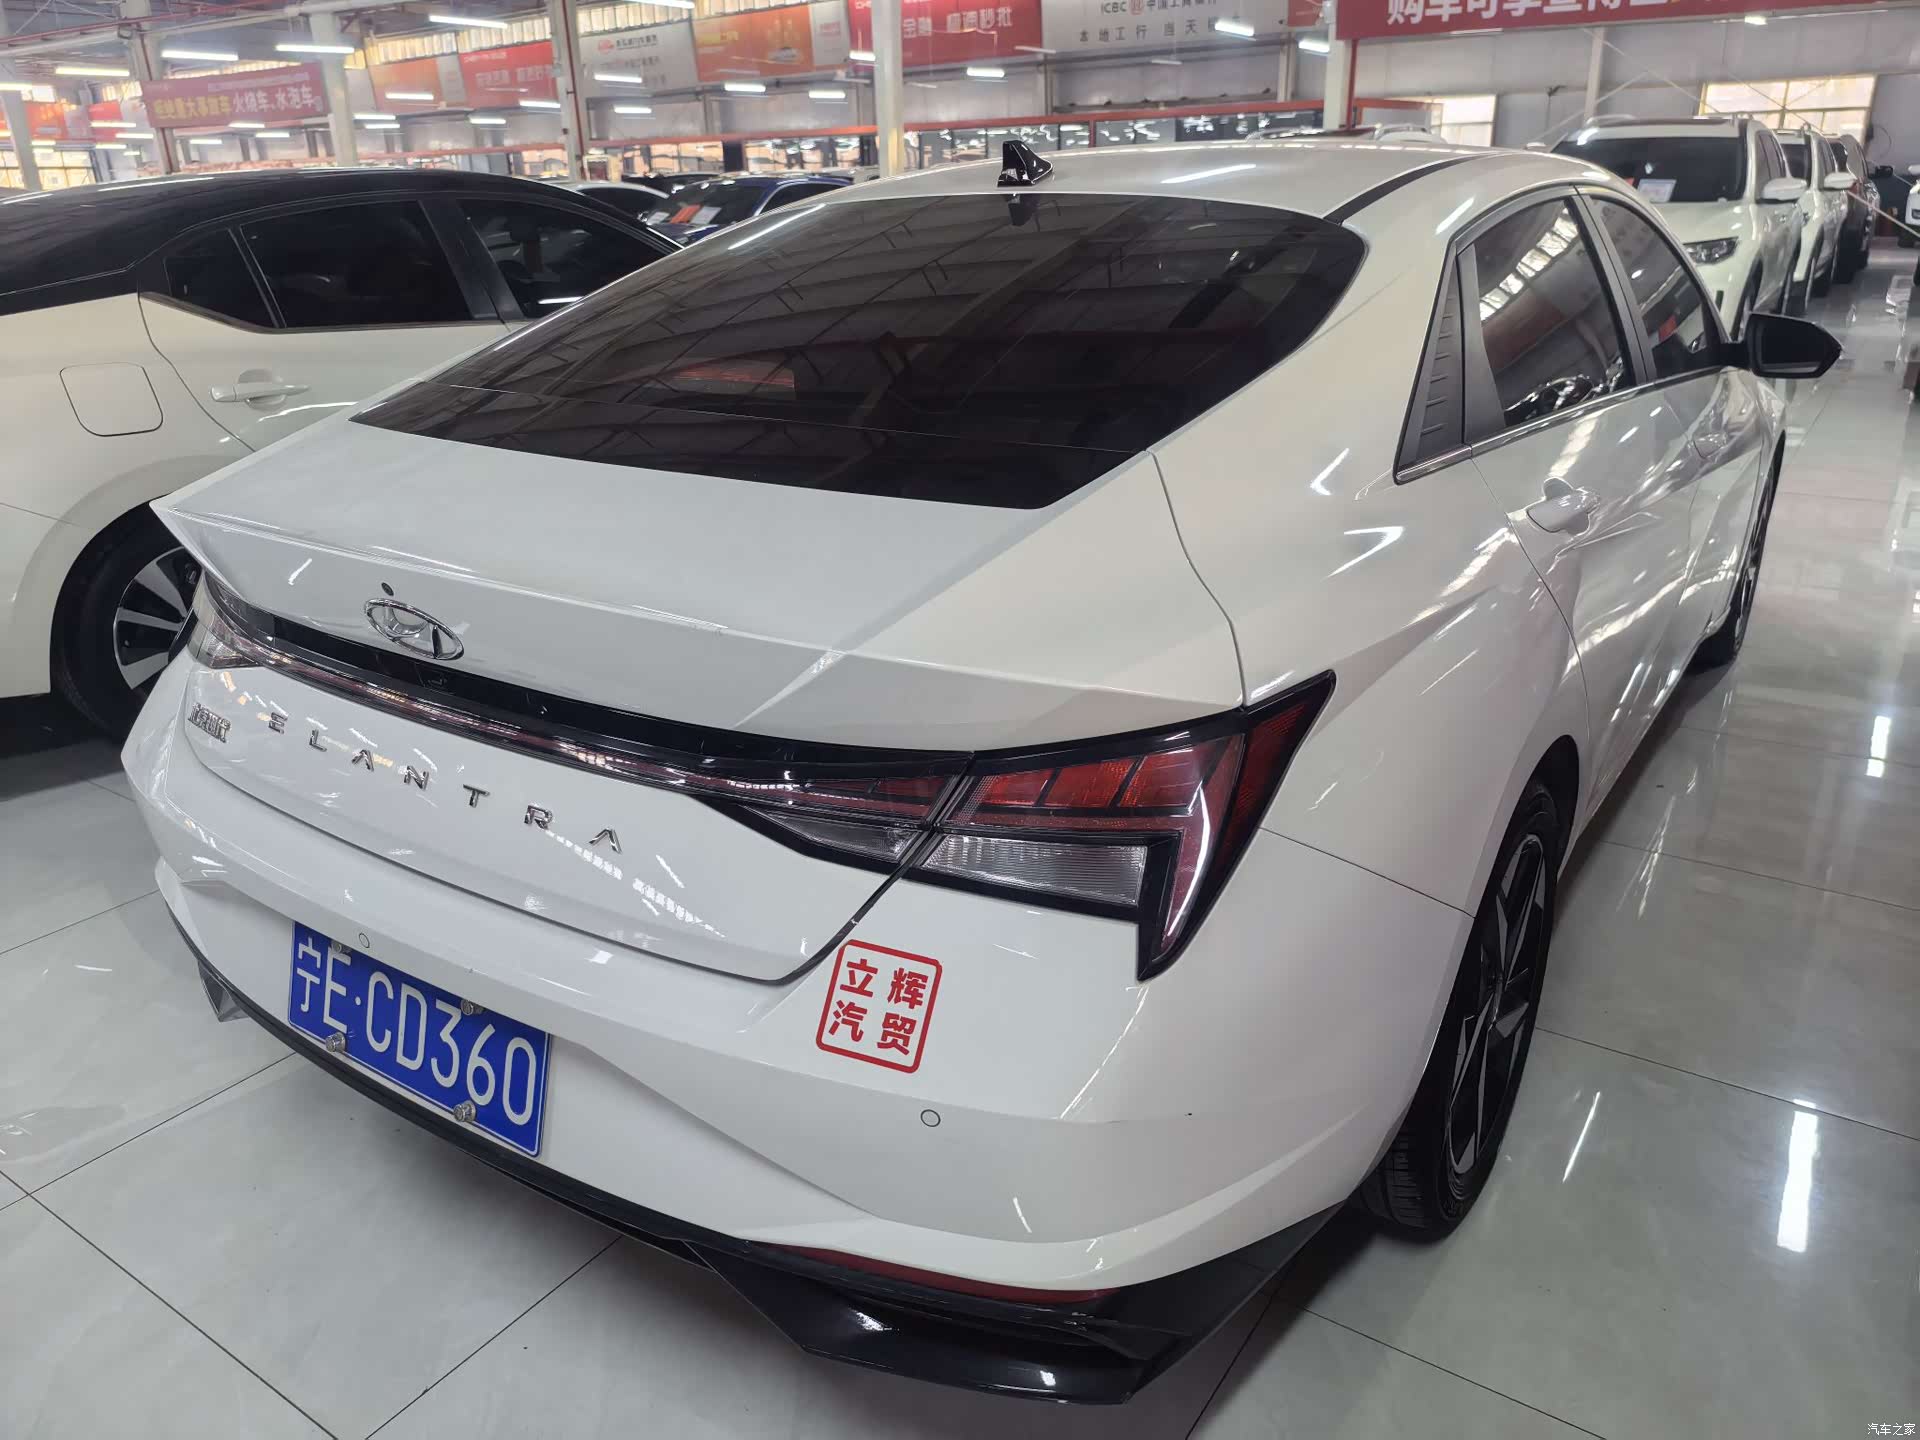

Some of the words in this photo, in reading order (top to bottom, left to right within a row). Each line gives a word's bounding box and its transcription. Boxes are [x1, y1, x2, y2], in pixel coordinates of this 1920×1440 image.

[1101, 2, 1127, 14] ICBC
[268, 711, 623, 855] ELANTRA
[840, 958, 929, 1009] 立辉
[828, 1000, 917, 1055] 汽贸
